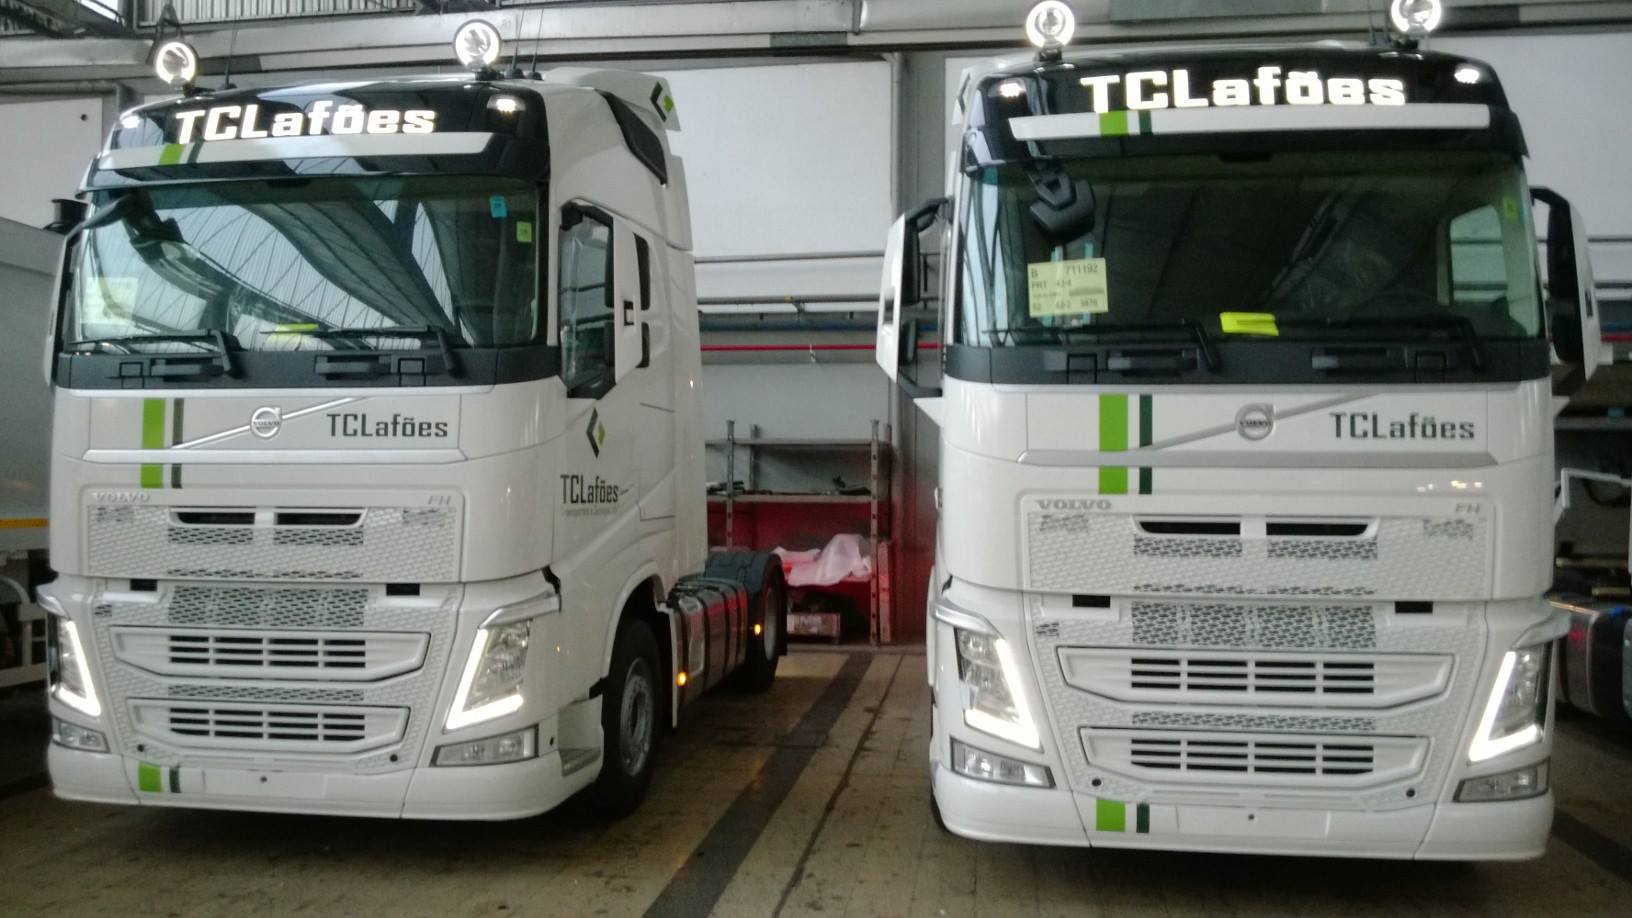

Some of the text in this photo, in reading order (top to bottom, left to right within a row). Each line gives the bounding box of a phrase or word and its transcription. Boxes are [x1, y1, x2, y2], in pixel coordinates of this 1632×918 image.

[1080, 66, 1406, 113] TCLafões
[175, 100, 436, 144] TCLafões
[326, 413, 449, 437] TCLafões
[1330, 412, 1475, 439] TCLafões
[93, 491, 151, 502] VOLVO
[560, 474, 619, 504] TCLafões
[1035, 499, 1112, 510] VOLVO
